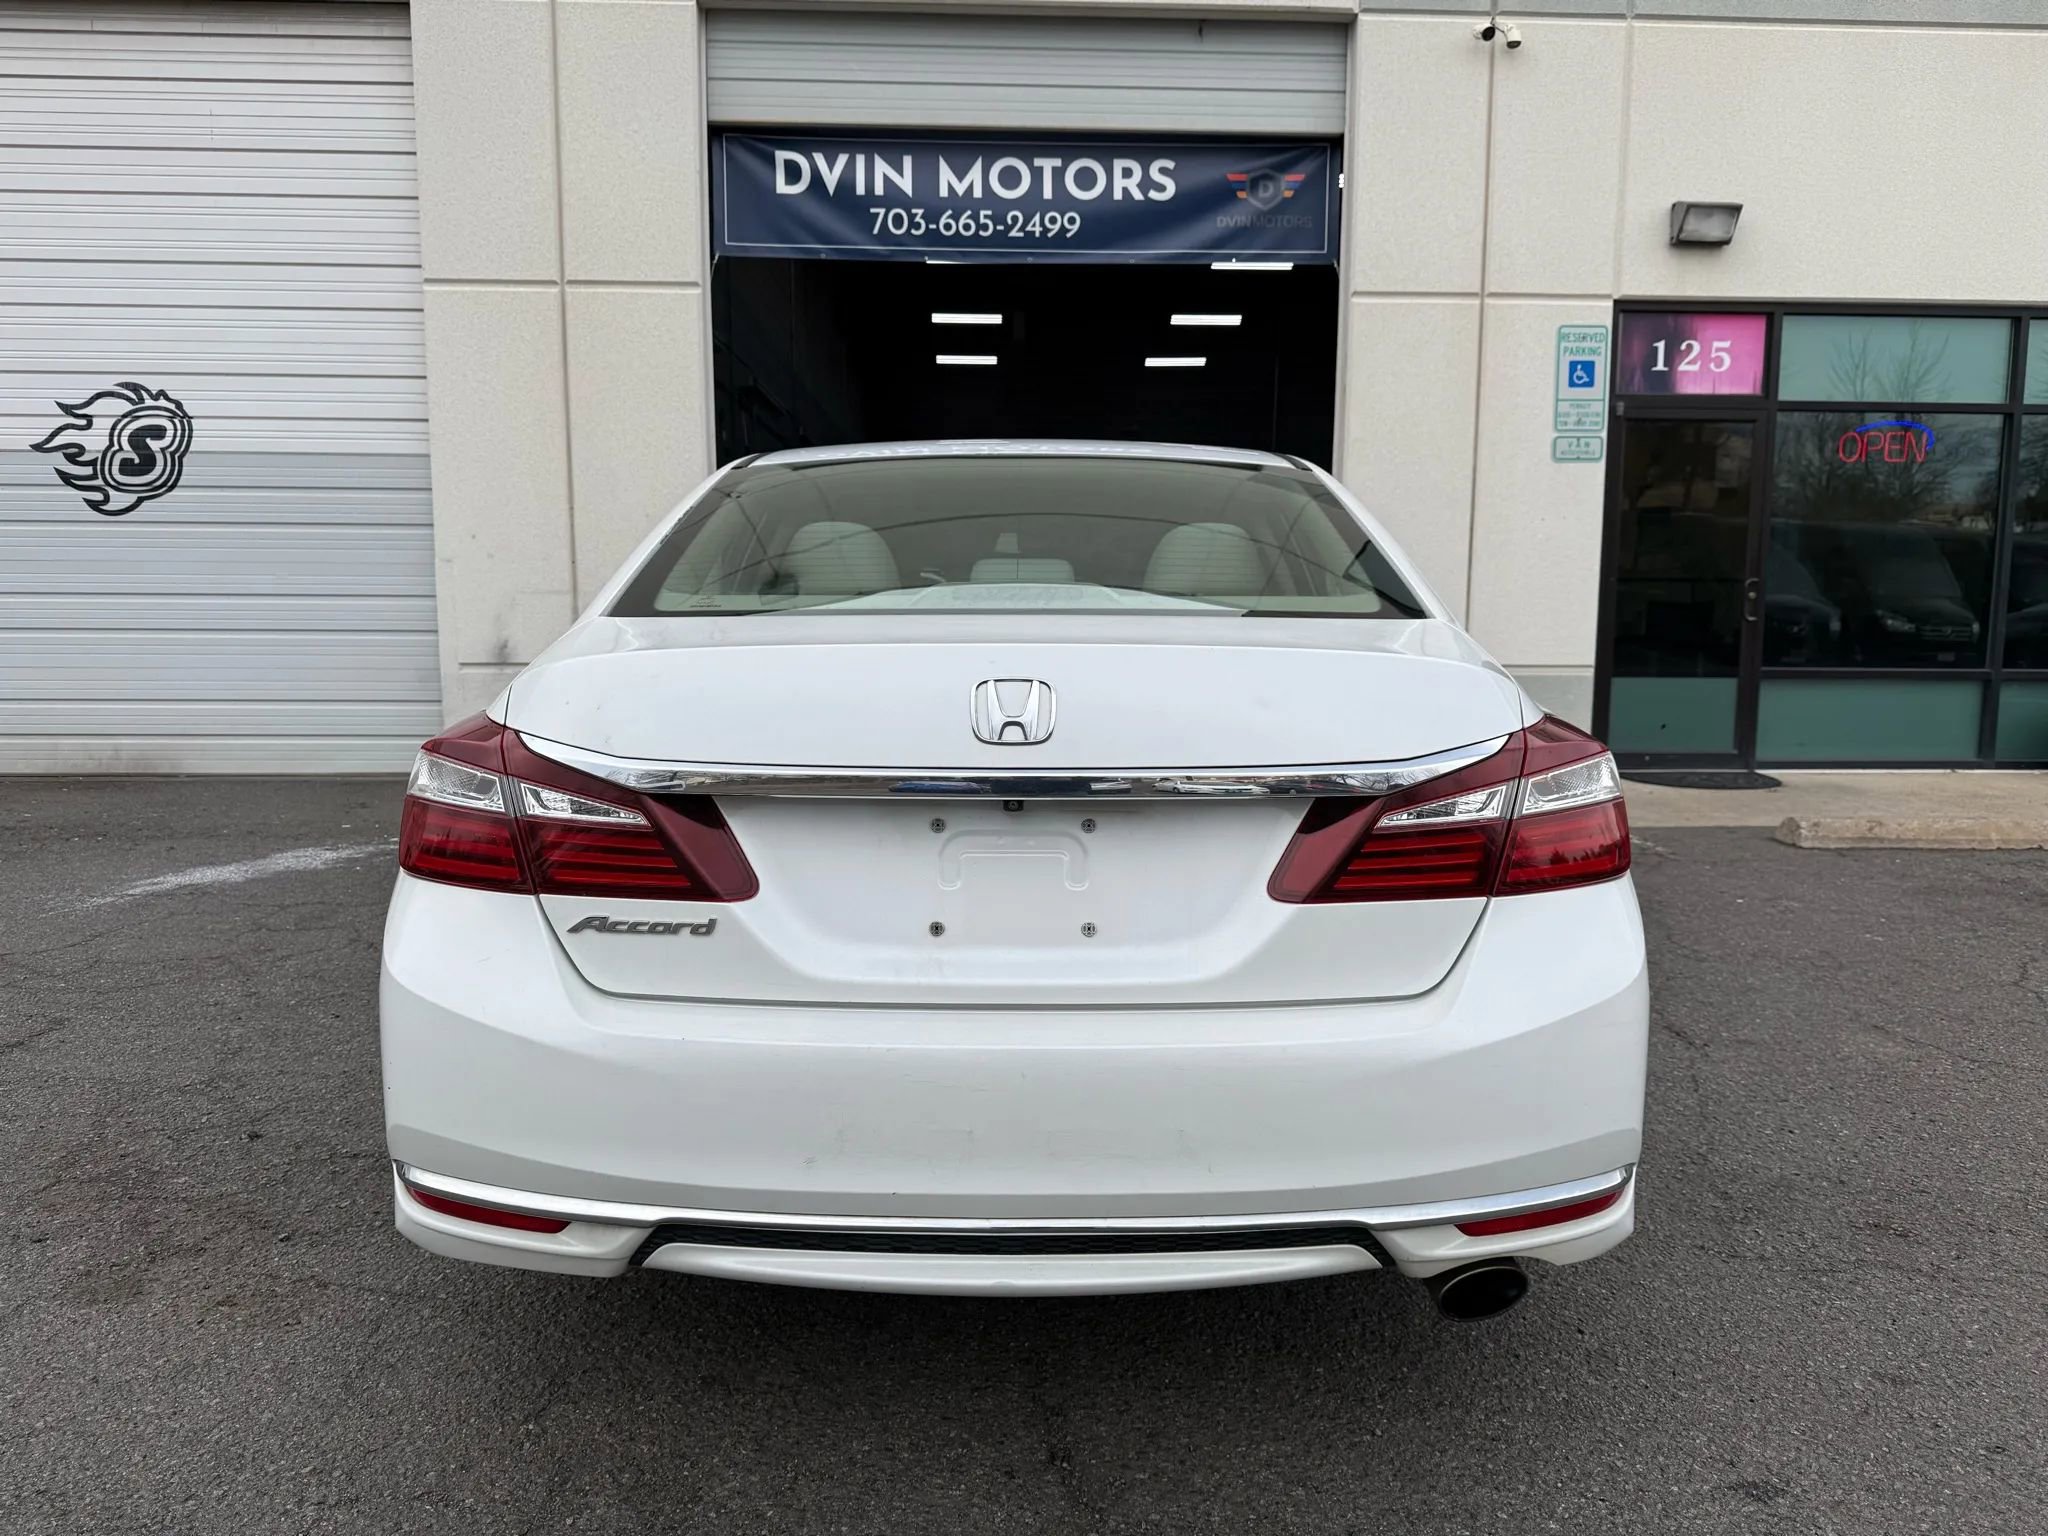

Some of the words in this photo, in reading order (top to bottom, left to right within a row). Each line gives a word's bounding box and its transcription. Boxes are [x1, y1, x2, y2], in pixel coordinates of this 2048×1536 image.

[774, 150, 912, 198] DVIN
[939, 155, 1176, 201] MOTORS
[870, 208, 1082, 238] 703-665-2499
[1560, 332, 1606, 343] RESERVED
[1563, 346, 1602, 356] PARKING
[1651, 339, 1731, 372] 125
[1839, 431, 1928, 463] OPEN
[567, 916, 717, 936] Accord
